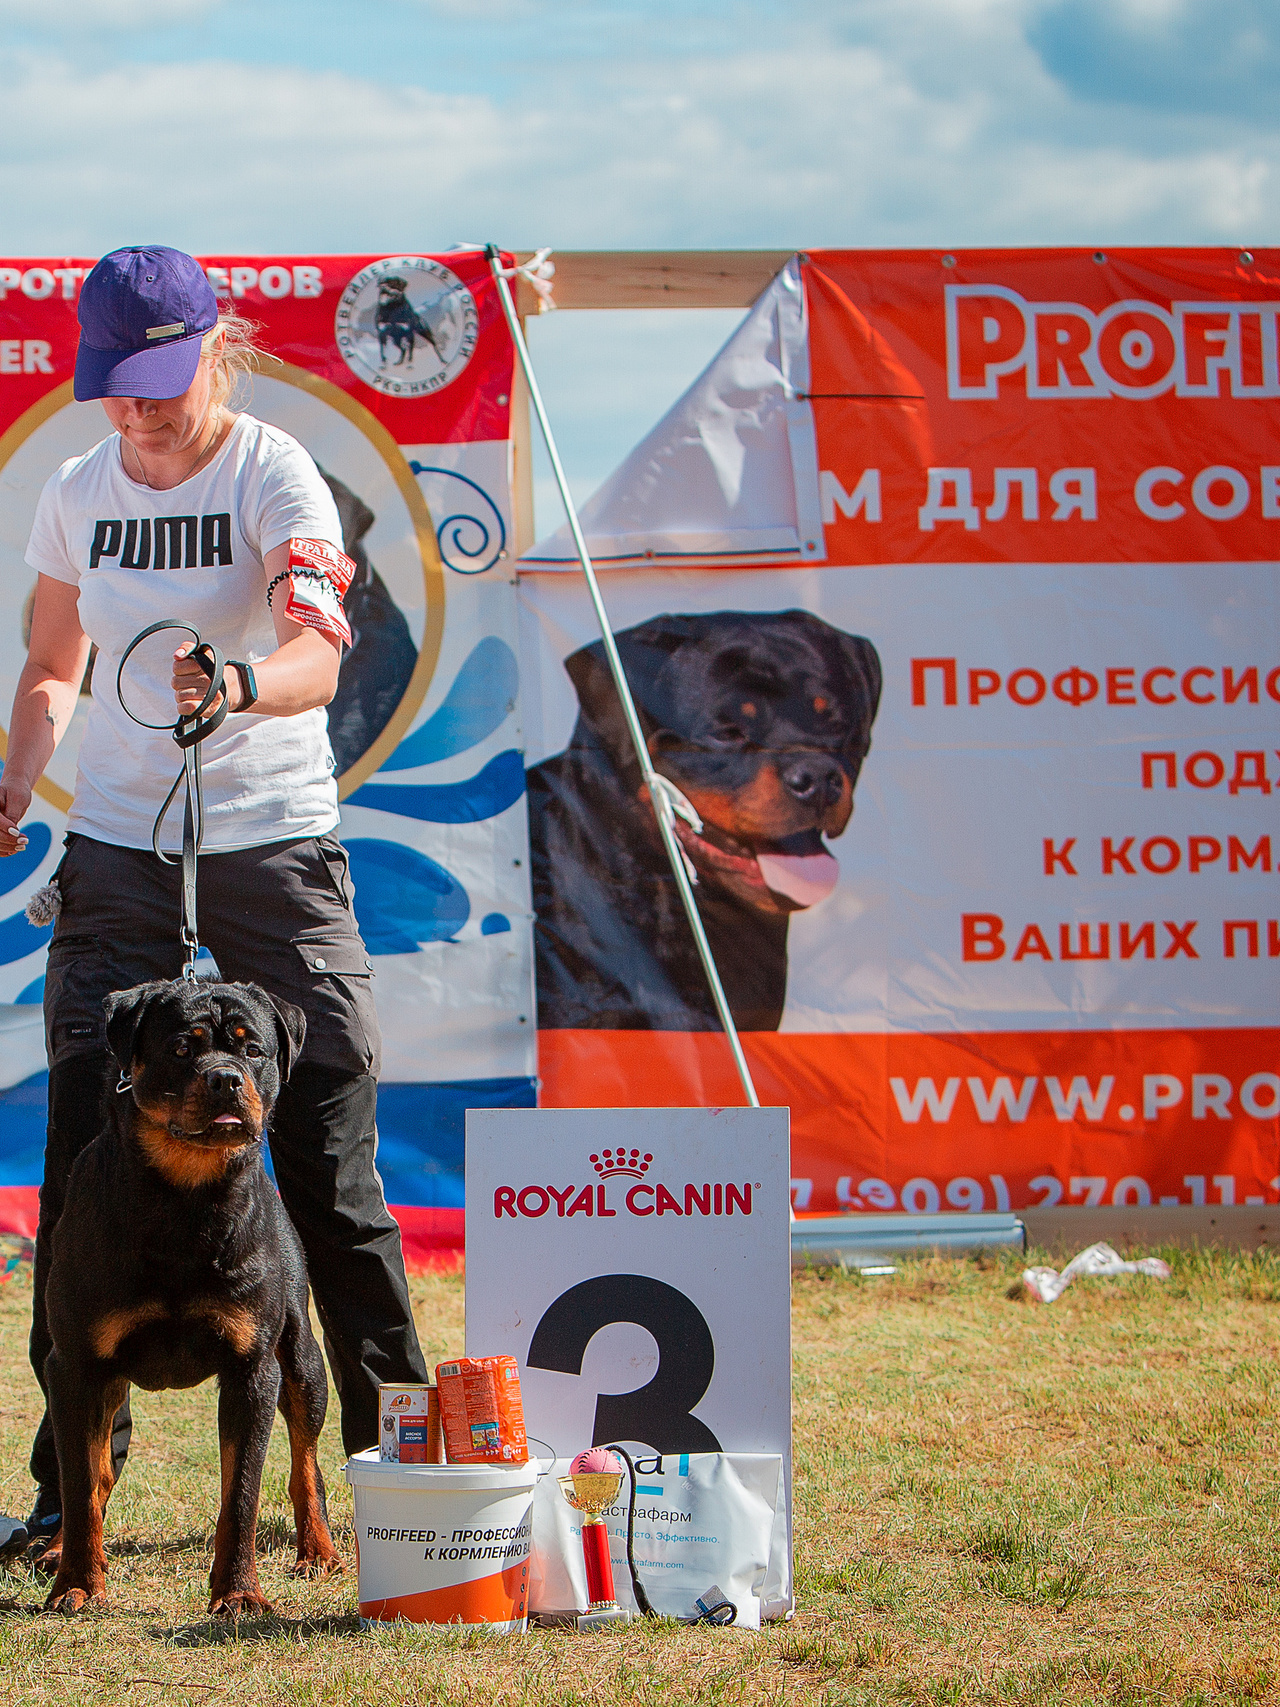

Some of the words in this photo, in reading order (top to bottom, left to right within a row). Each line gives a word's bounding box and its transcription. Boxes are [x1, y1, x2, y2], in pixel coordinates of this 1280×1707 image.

[944, 283, 1280, 400] PROFI
[919, 465, 1098, 532] ДЛЯ
[89, 512, 234, 571] PUMA
[296, 539, 352, 578] ТРАПЗА
[1140, 750, 1280, 796] ПОД
[1101, 834, 1280, 876] КОРМ
[493, 1183, 617, 1219] ROYAL
[625, 1182, 753, 1217] CANIN
[1027, 1173, 1280, 1208] 270-11-
[526, 1273, 724, 1453] 3
[367, 1526, 436, 1543] PROFIFEED
[451, 1524, 531, 1543] ПРОФЕССИОН
[424, 1548, 435, 1561] К
[438, 1543, 522, 1561] КОРМЛЕНИЮ
[615, 1527, 653, 1540] Прсто.
[655, 1531, 720, 1544] Эффективно.
[610, 1558, 685, 1569] ww.atrafarm.com
